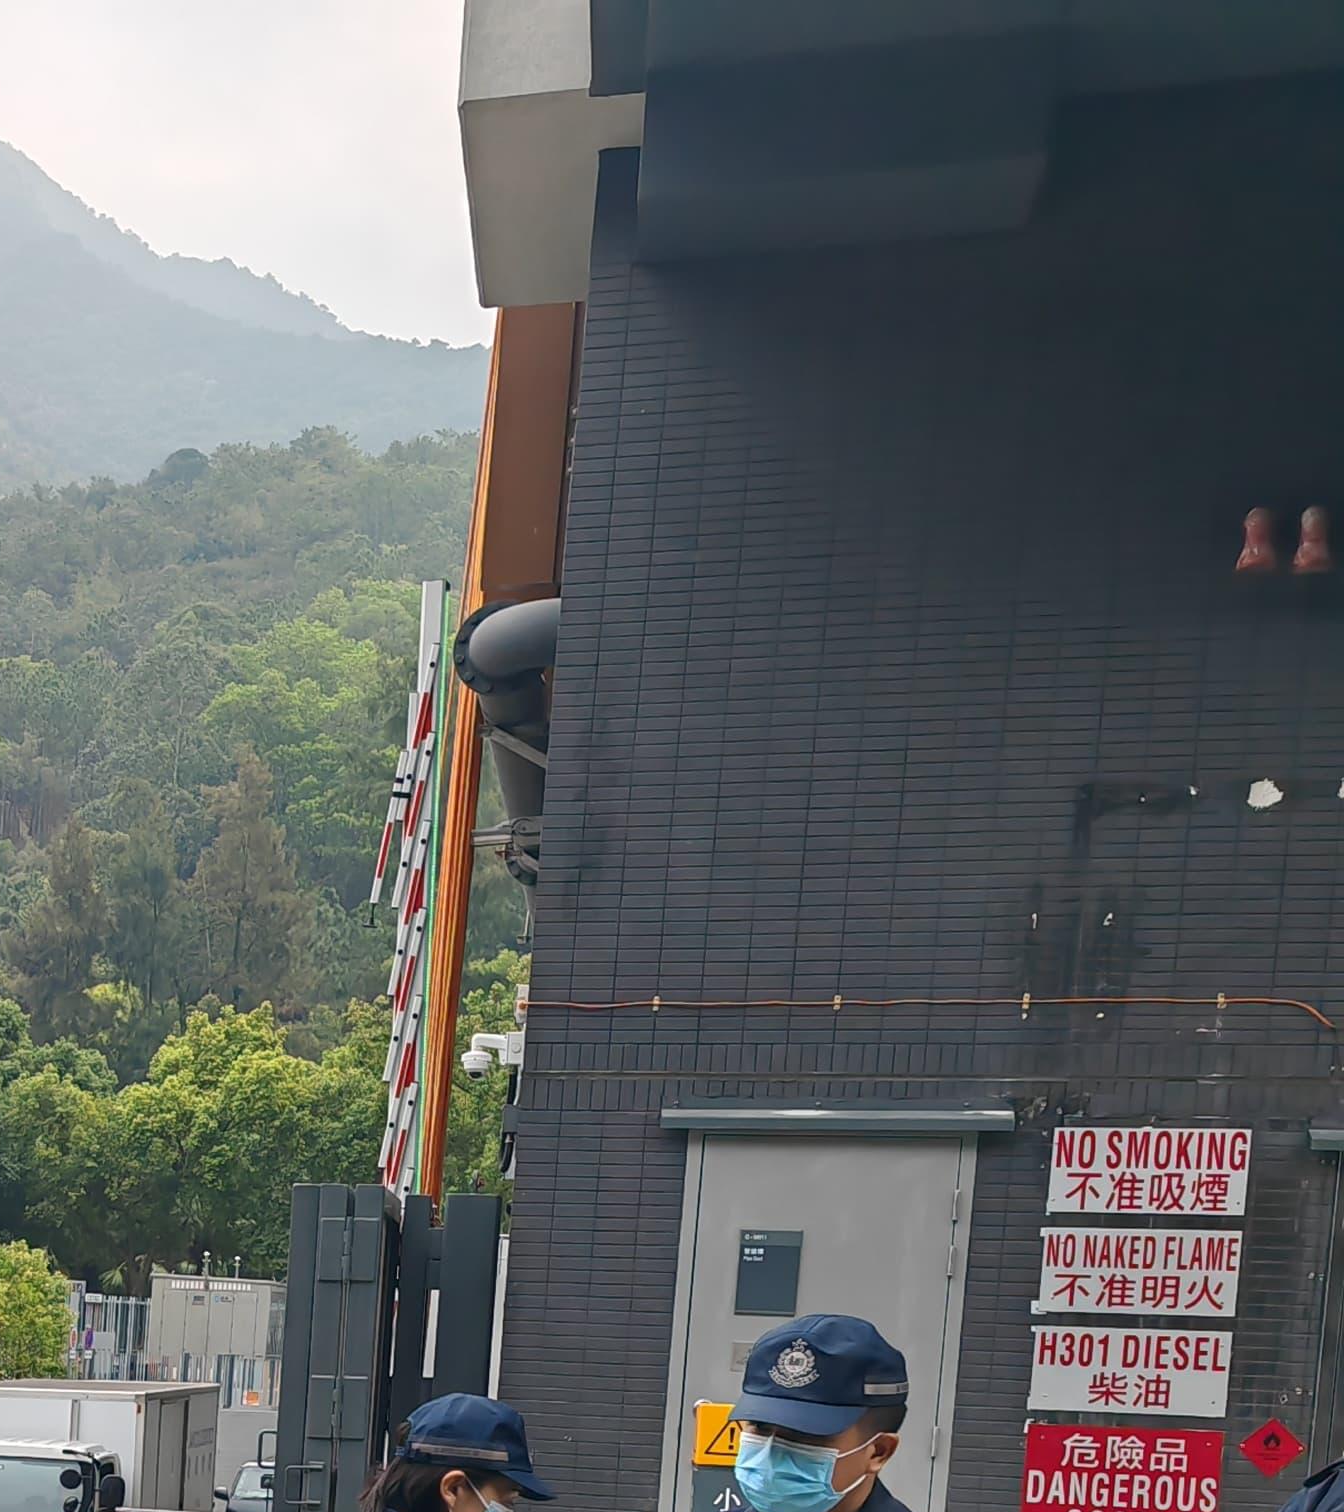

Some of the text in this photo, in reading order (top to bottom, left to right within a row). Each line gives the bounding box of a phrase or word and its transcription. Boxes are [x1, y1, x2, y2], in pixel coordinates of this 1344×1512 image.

[1056, 1130, 1248, 1171] NO SMOKING
[1065, 1172, 1231, 1212] 不准吸煙
[1046, 1233, 1238, 1272] NO NAKED FLAME
[1053, 1274, 1225, 1311] 不准明火
[1038, 1332, 1226, 1372] H301 DIESEL
[1088, 1372, 1171, 1409] 柴油
[1061, 1433, 1188, 1472] 危險品
[1026, 1469, 1217, 1512] DANGEROUS
